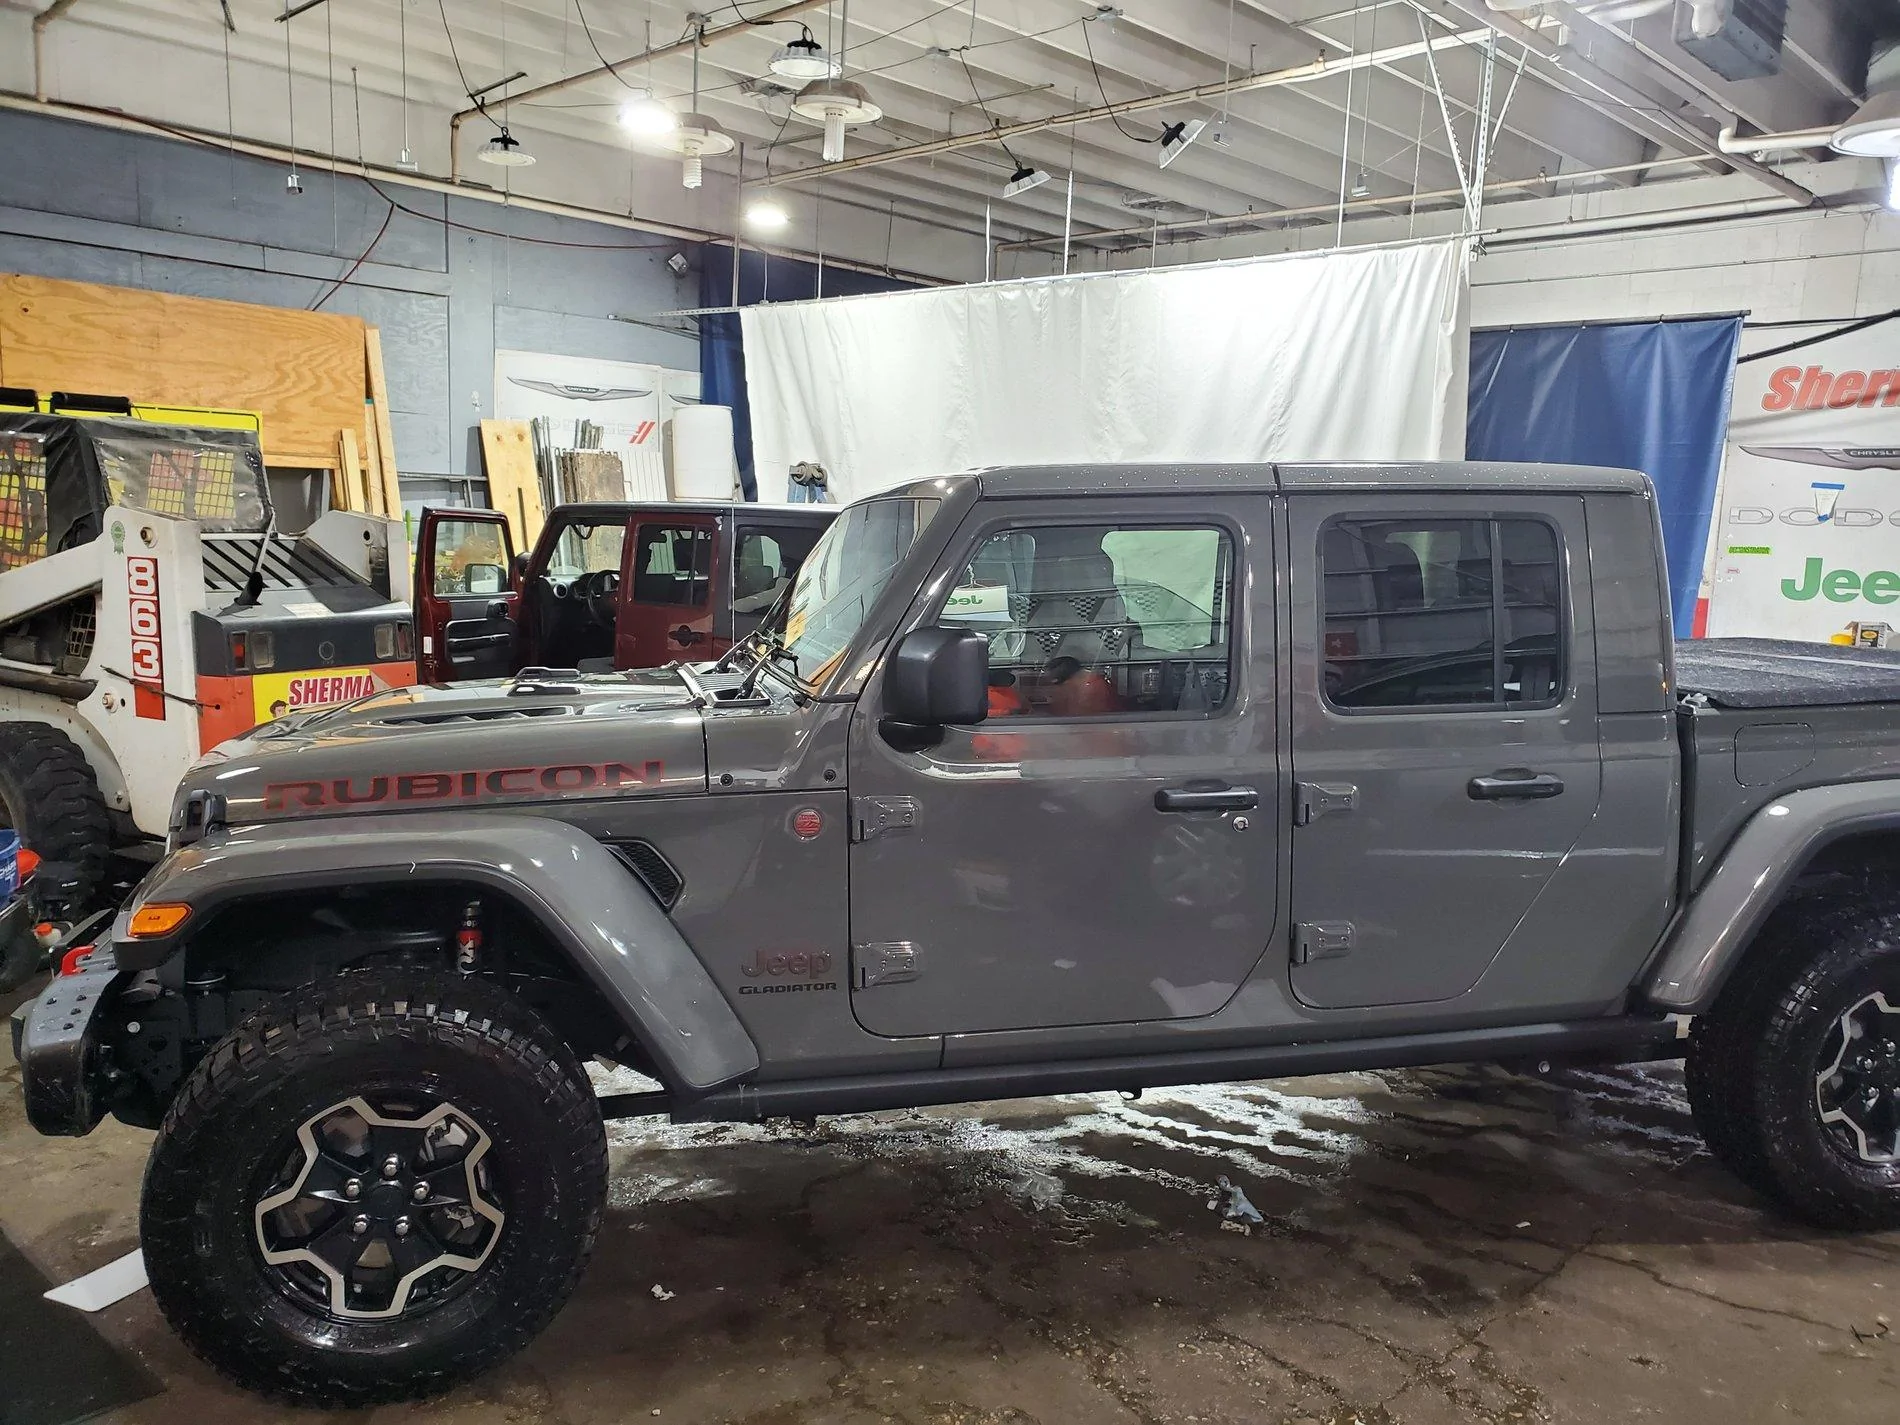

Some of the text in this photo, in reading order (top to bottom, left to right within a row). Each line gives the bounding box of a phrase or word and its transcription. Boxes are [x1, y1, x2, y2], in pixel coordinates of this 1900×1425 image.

[1761, 365, 1900, 411] Sher
[1728, 507, 1900, 527] DOD
[128, 558, 160, 677] 863
[288, 675, 375, 706] SHERMA
[264, 760, 664, 810] RUBICON
[741, 948, 831, 979] Jeep
[739, 982, 837, 995] GLADIATOR
